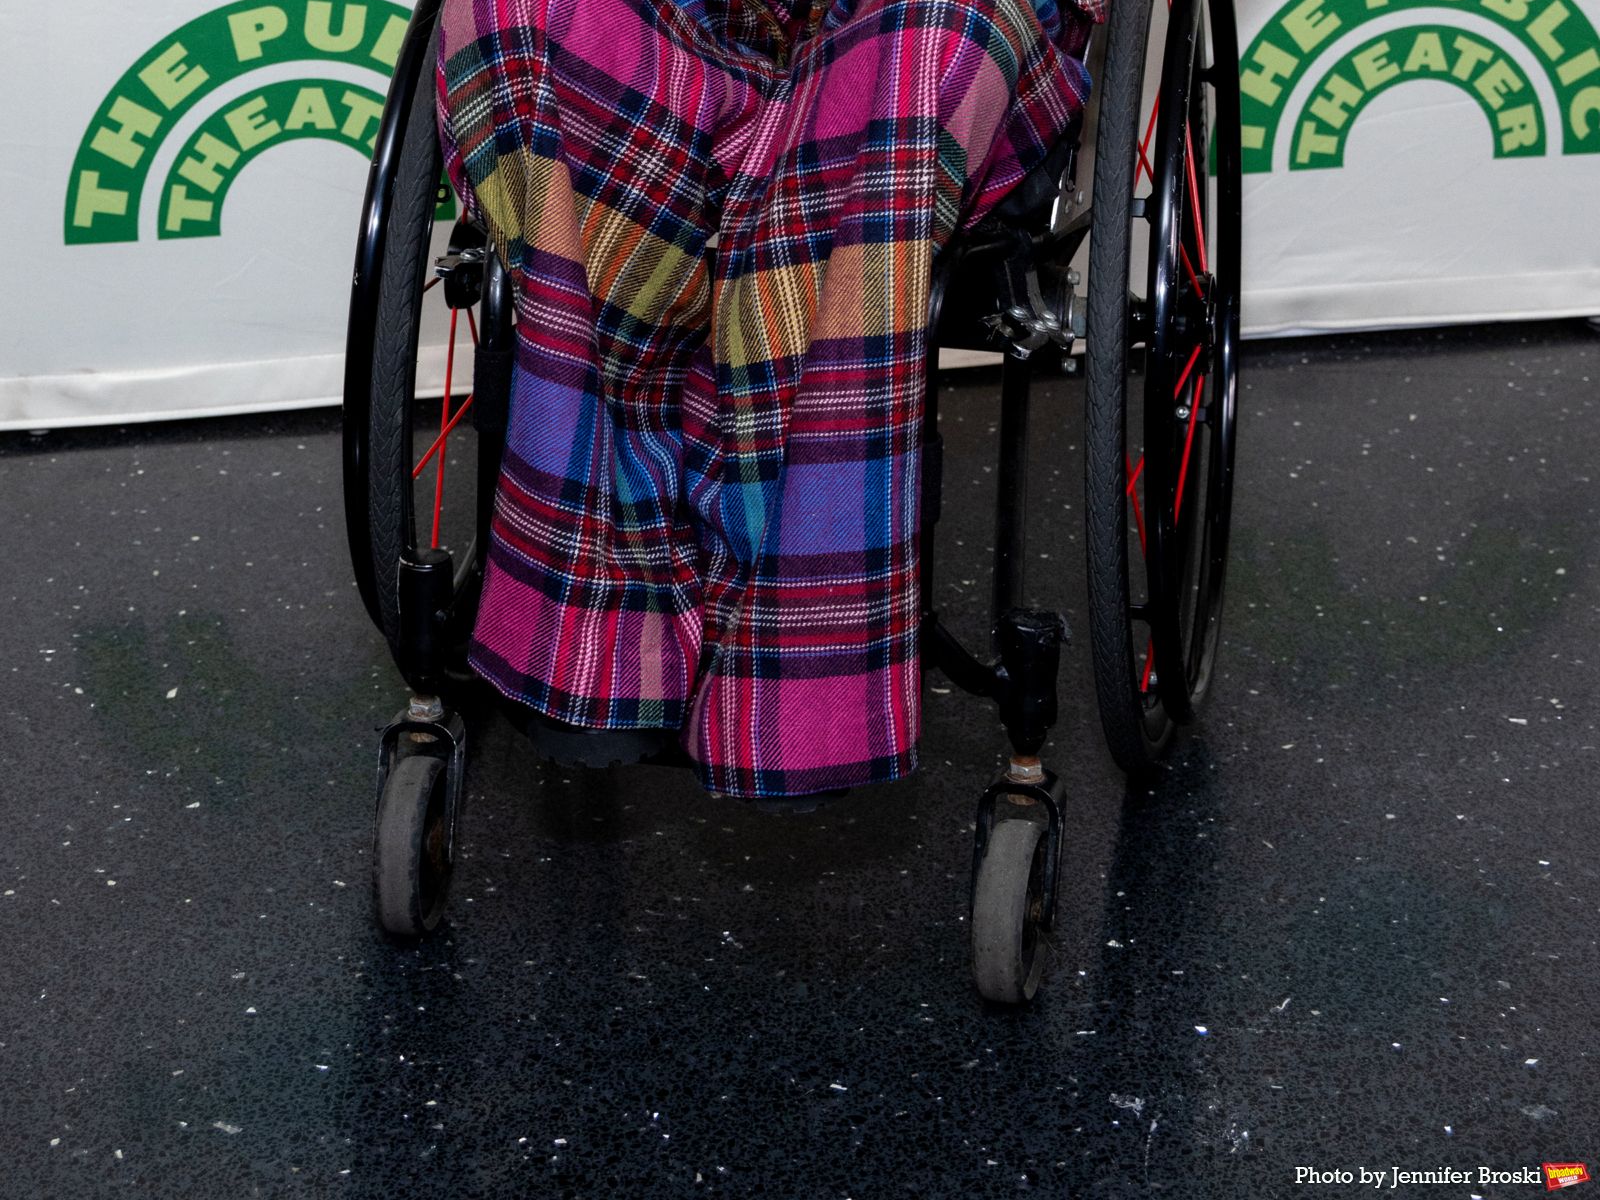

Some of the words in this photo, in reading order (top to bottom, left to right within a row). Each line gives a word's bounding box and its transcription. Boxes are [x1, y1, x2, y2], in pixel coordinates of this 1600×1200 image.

[73, 42, 210, 228] THE
[165, 87, 386, 232] THEAT
[1296, 32, 1539, 164] THEATER
